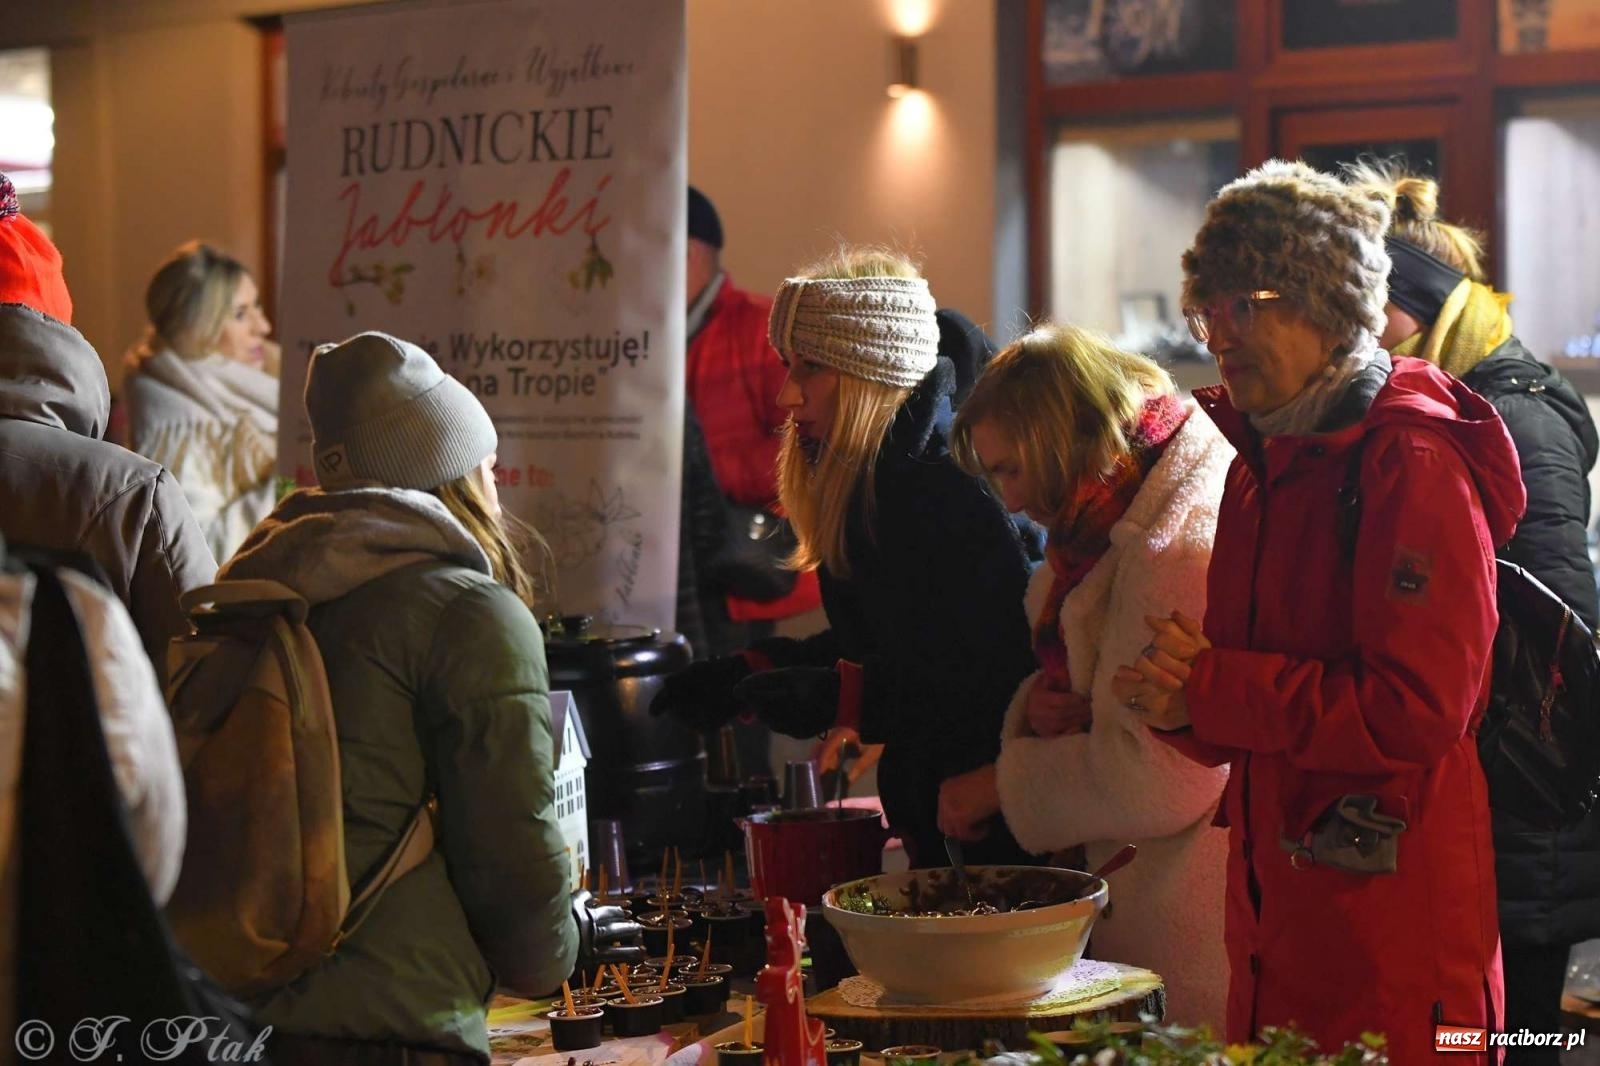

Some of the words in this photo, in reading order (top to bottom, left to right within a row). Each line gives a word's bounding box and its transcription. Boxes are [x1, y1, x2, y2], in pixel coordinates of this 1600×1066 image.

[340, 105, 614, 177] RUDNICKIE
[329, 167, 614, 287] Jabłonki
[449, 330, 650, 369] Wykorzystuję!
